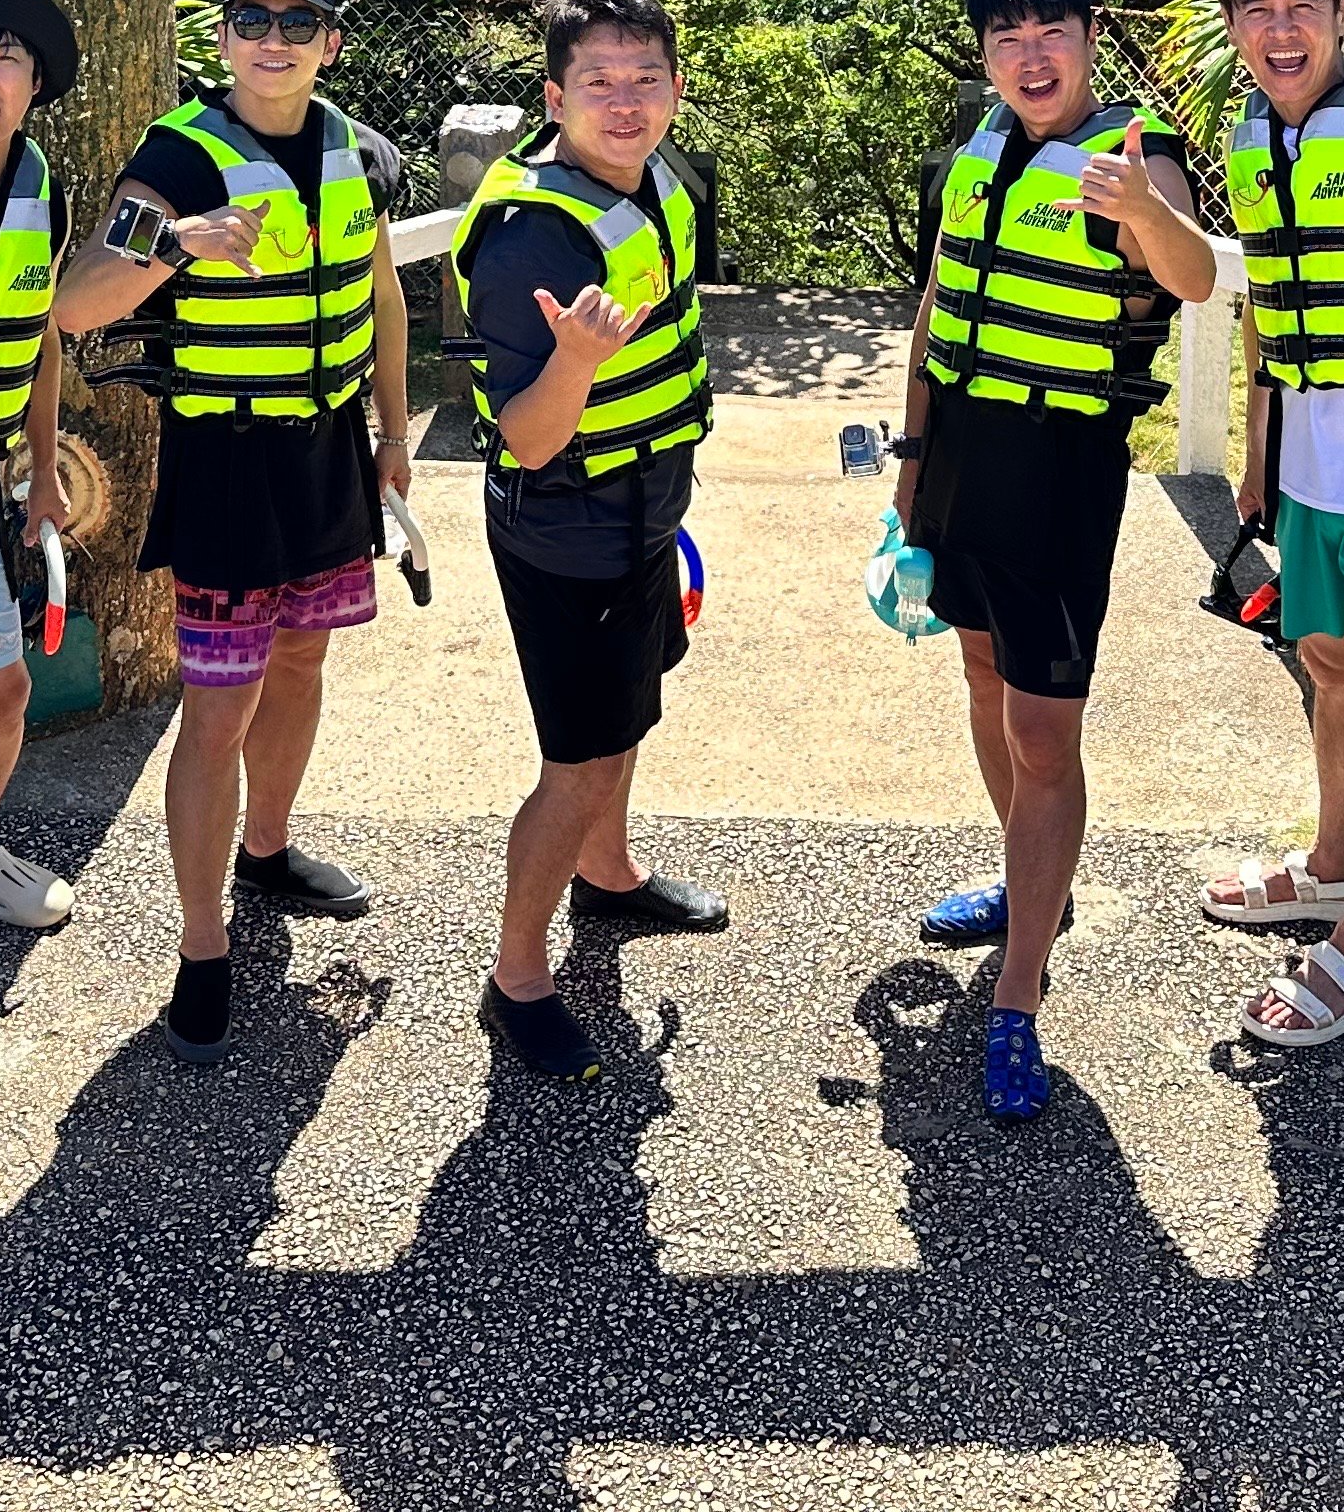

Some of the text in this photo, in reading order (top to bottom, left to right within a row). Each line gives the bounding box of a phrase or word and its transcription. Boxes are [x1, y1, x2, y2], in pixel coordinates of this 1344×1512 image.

[1014, 208, 1071, 233] ADVENTURE
[1032, 202, 1075, 221] SAIPAN
[22, 265, 51, 279] SAIPA
